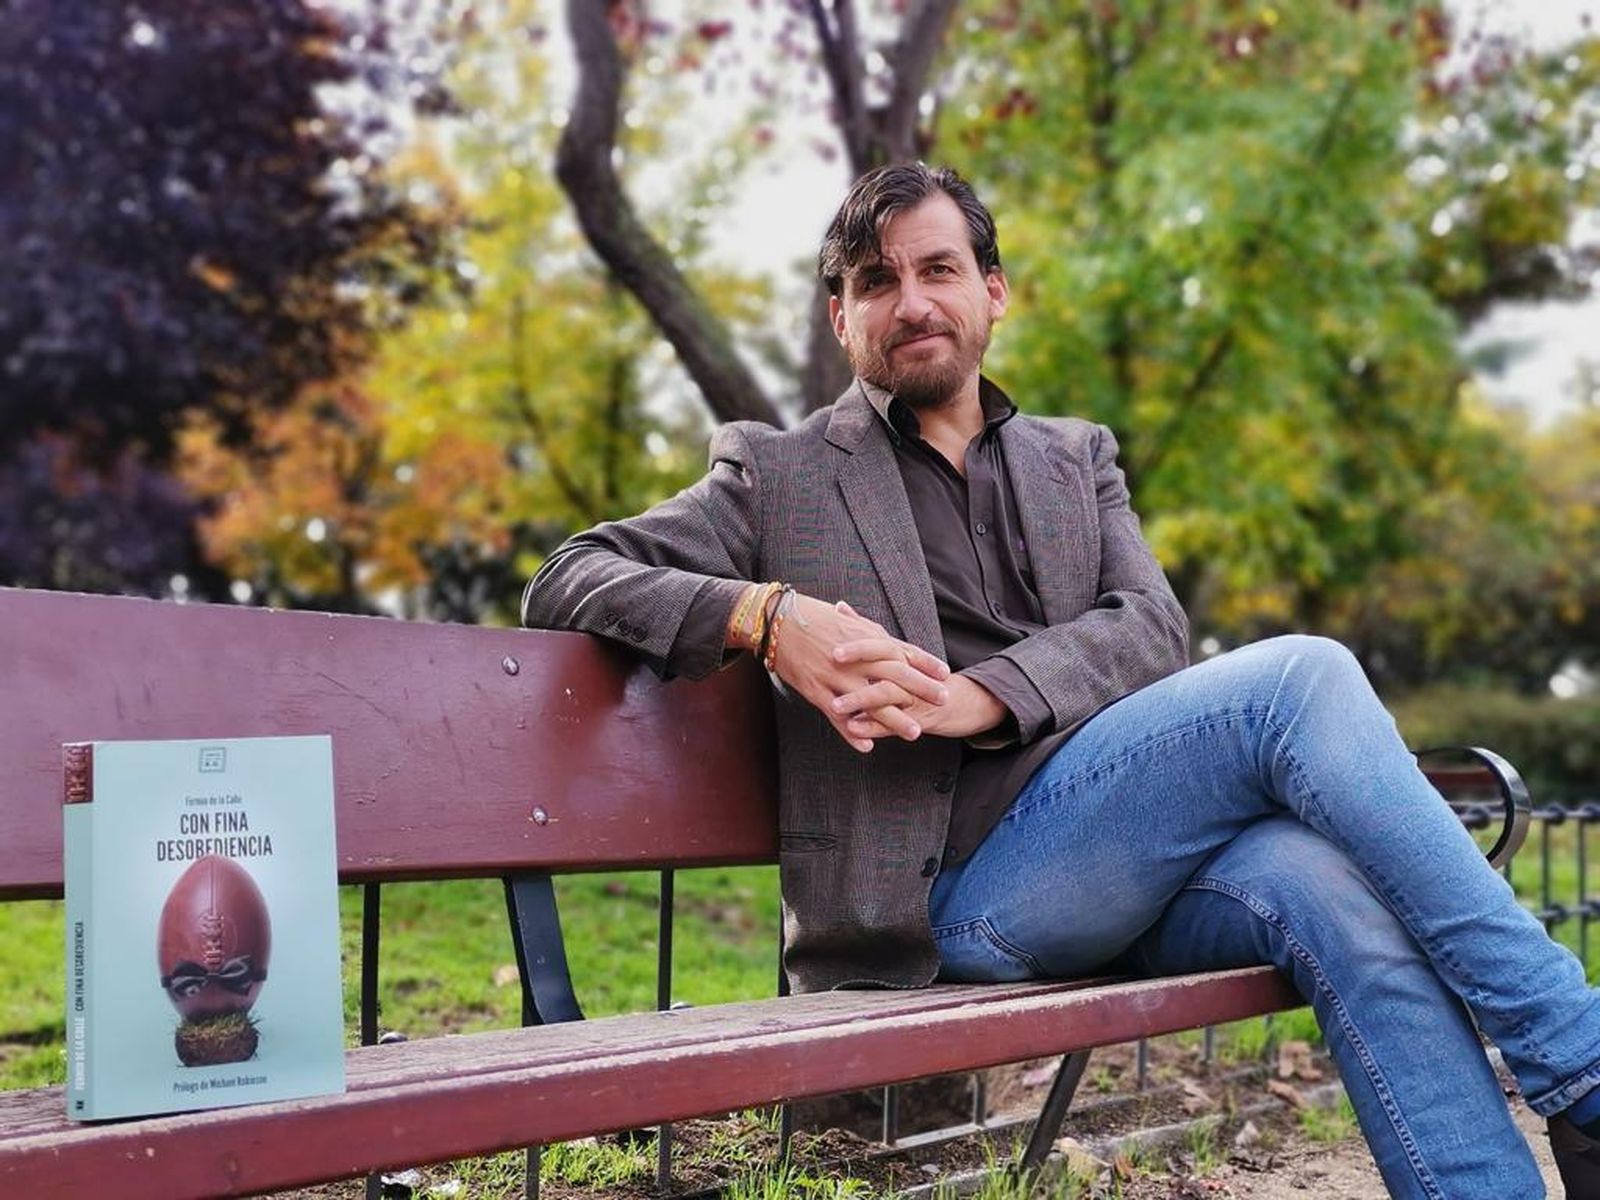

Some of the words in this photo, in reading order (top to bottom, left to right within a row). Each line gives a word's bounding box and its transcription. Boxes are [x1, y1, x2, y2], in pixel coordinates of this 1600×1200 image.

[180, 813, 210, 835] CON
[215, 811, 249, 833] FINA
[157, 835, 273, 862] DESOBEDIENCIA
